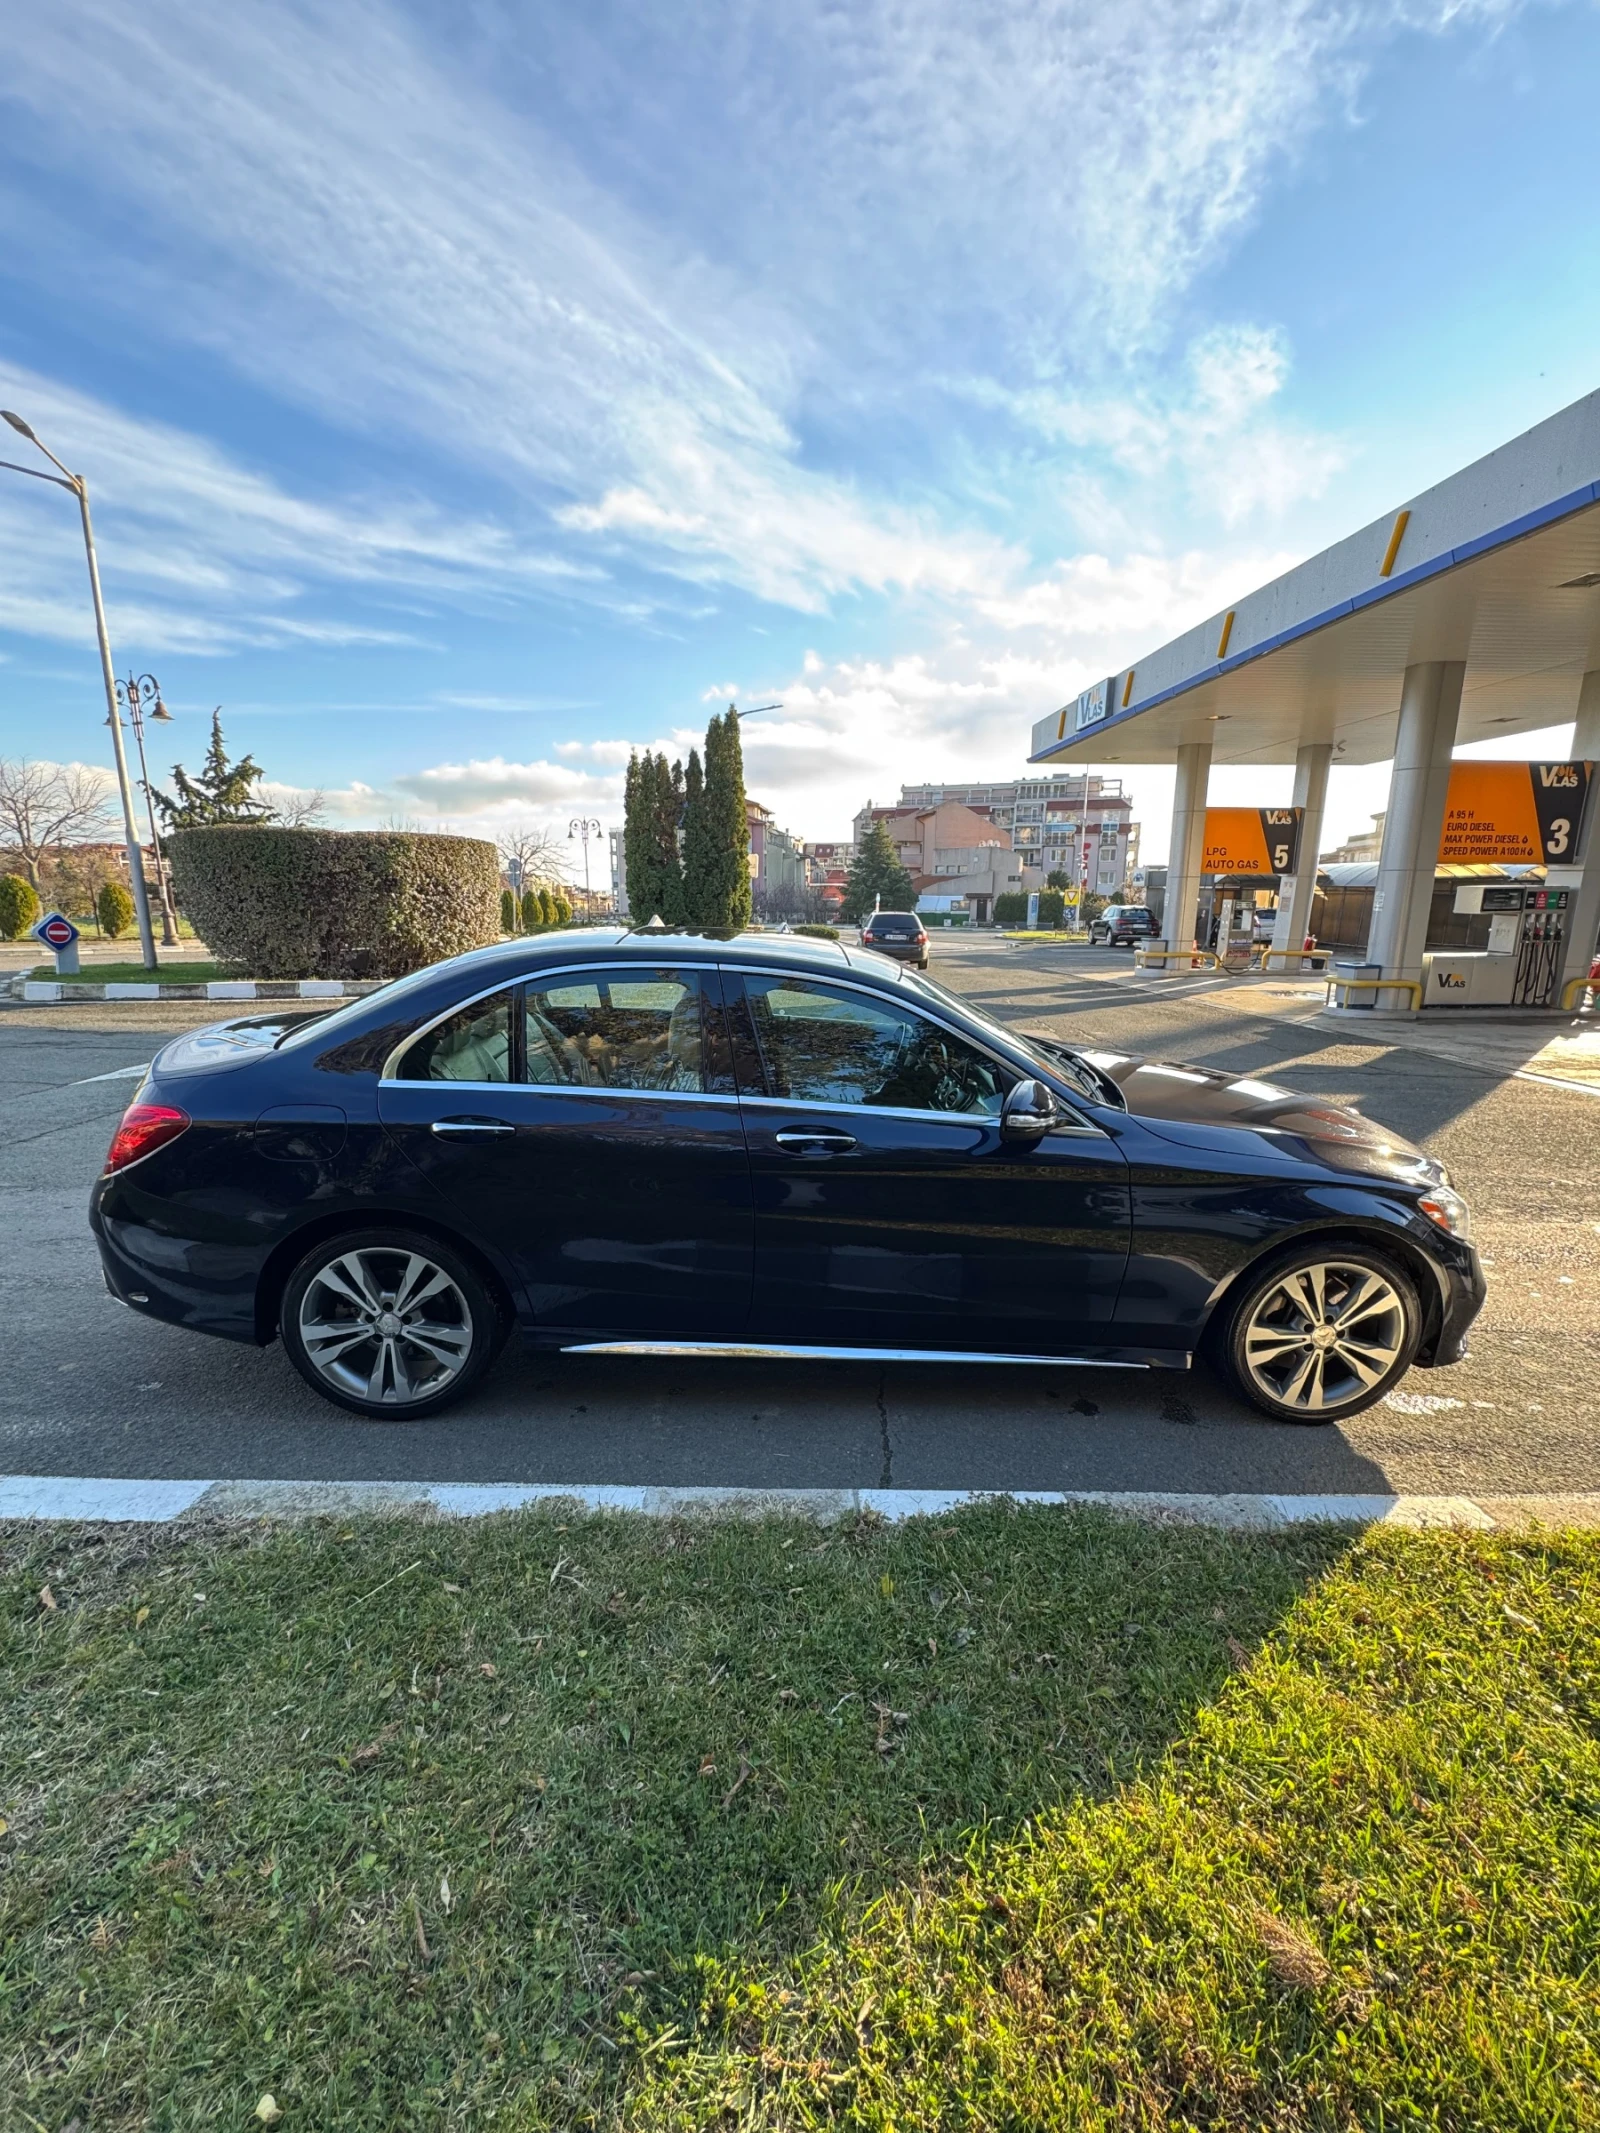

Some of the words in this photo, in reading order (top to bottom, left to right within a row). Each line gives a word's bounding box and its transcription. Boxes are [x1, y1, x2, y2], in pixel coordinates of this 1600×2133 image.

[1081, 692, 1103, 724] VLAS
[1539, 765, 1579, 788] VLAS
[1265, 810, 1292, 825] VLAS
[1448, 810, 1454, 819] A
[1456, 810, 1466, 819] 95
[1468, 810, 1474, 819] H
[1446, 822, 1468, 831] EURO
[1469, 822, 1496, 831] DIESEL
[1444, 834, 1463, 844] MAX
[1464, 834, 1493, 844] POWER
[1494, 834, 1520, 844] DIESEL
[1547, 818, 1571, 855] 3
[1206, 847, 1227, 856] LPG
[1273, 844, 1289, 869] 5
[1443, 846, 1468, 856] SPEED
[1469, 846, 1498, 856] POWER
[1205, 860, 1234, 869] AUTO
[1237, 860, 1259, 869] GAS
[1437, 973, 1466, 988] VLAS
